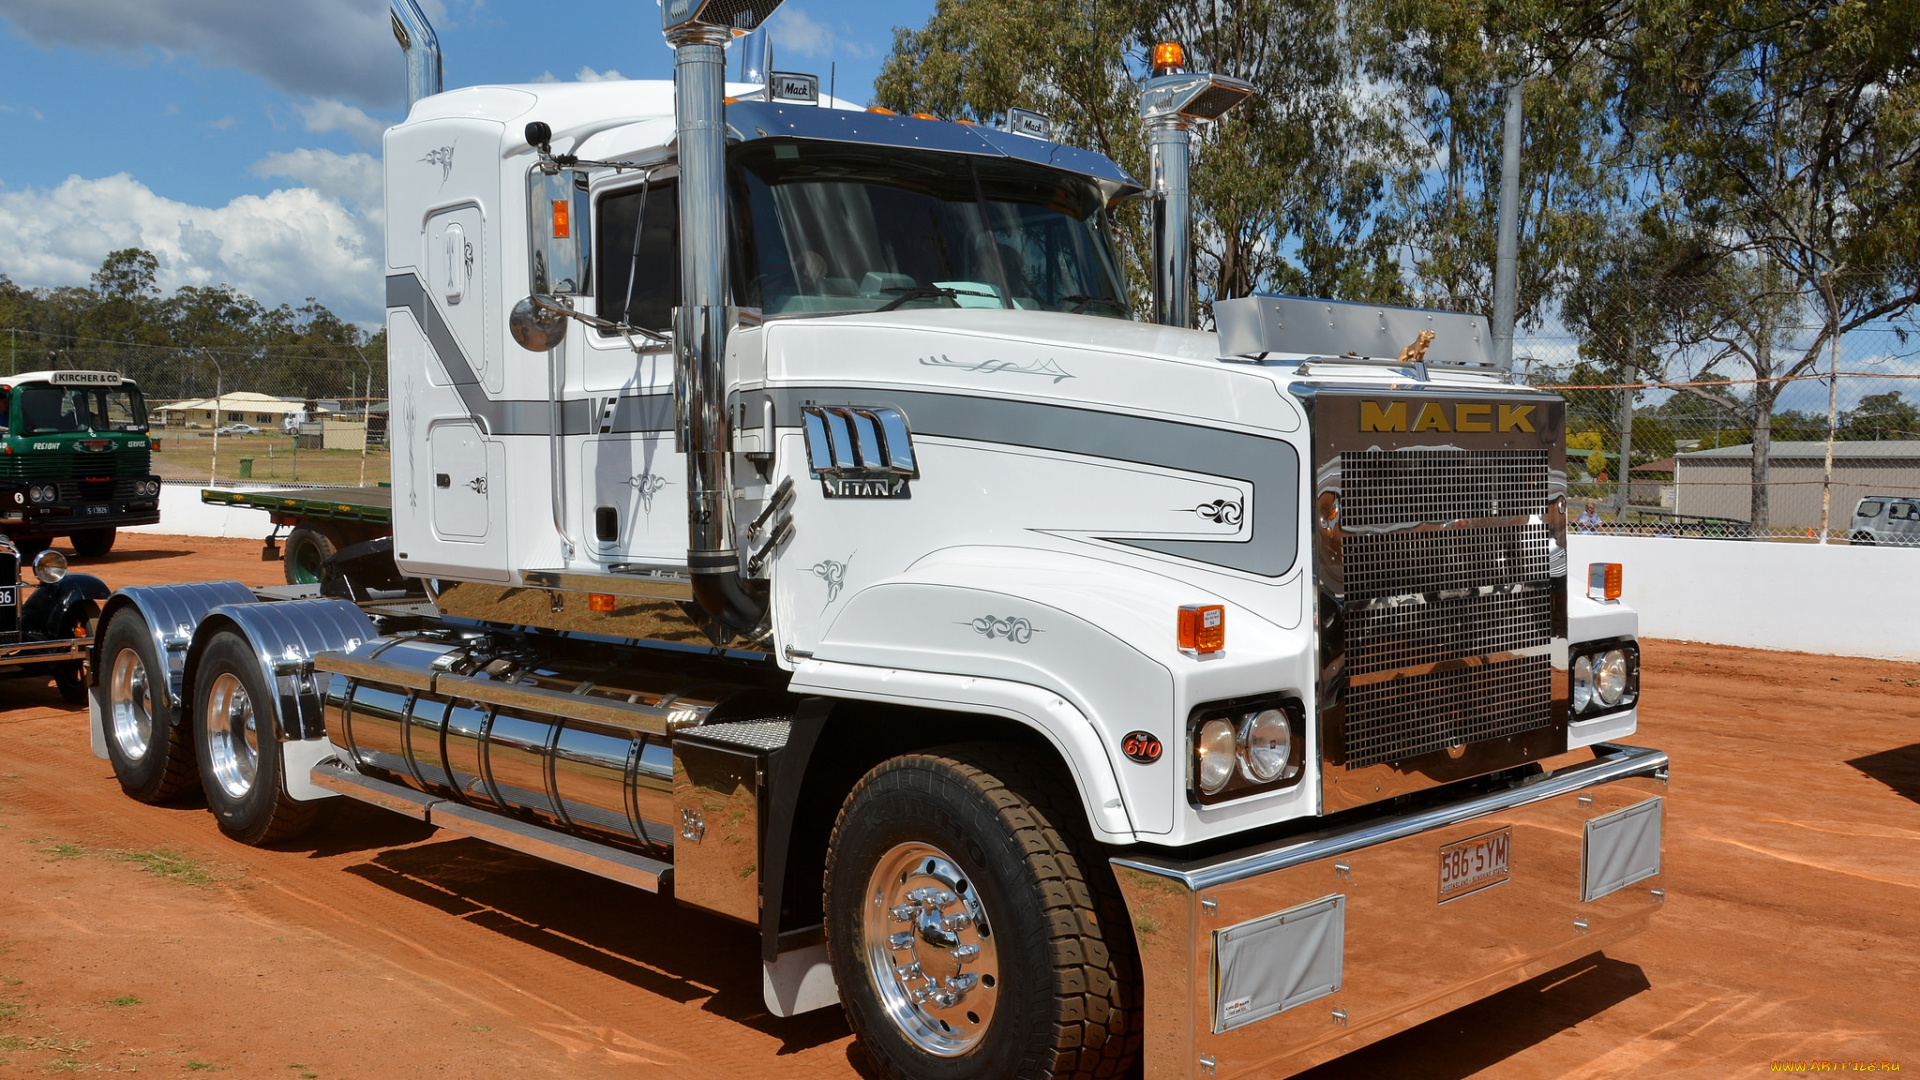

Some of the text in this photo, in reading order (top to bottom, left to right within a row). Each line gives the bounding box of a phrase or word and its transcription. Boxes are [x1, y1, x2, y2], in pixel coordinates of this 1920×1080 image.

[784, 82, 808, 96] Mack
[1023, 119, 1042, 133] Mack
[101, 374, 106, 382] &
[1359, 400, 1537, 433] MACK
[33, 442, 60, 450] FREIGHT
[1124, 739, 1161, 758] 610
